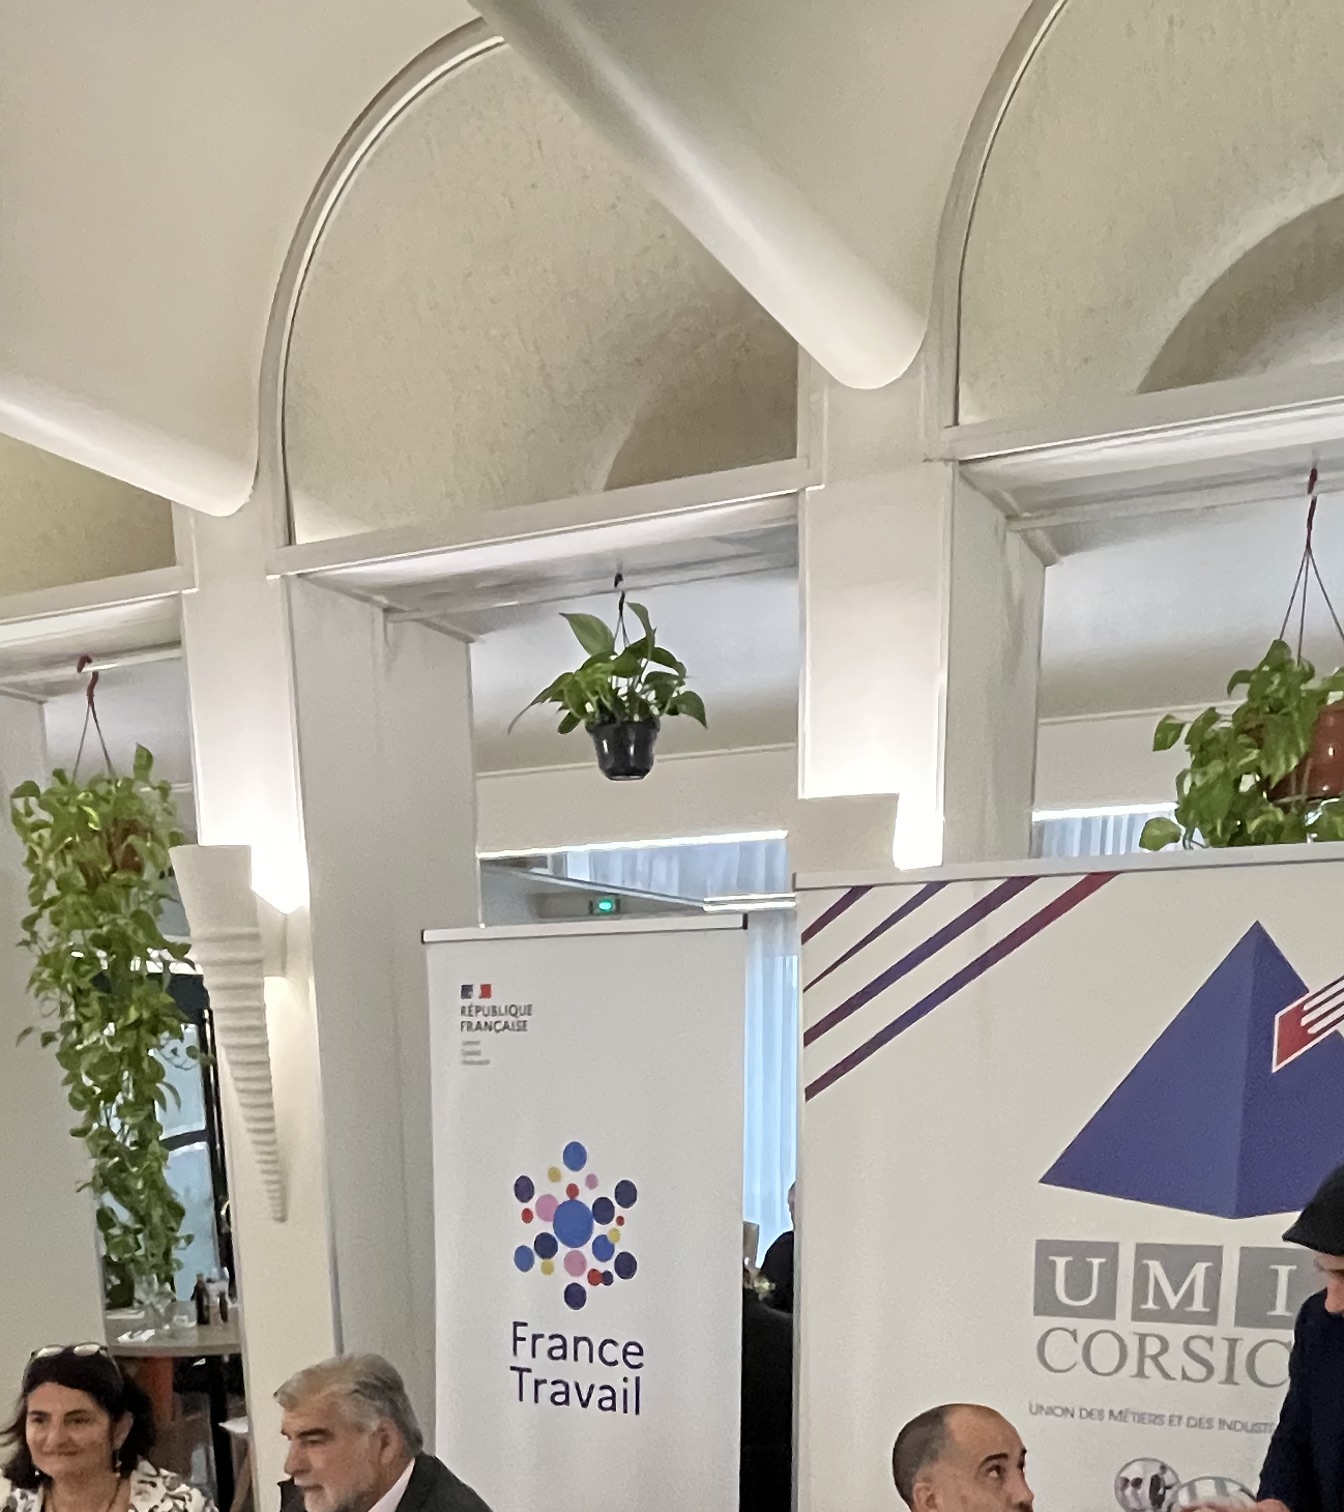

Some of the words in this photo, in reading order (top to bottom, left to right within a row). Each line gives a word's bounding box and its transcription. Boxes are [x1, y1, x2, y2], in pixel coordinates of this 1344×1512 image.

[460, 1003, 533, 1018] RÉPUBLIQUE
[460, 1020, 528, 1034] FRANÇAISE
[512, 1321, 644, 1369] France
[1036, 1327, 1293, 1388] CORSIC
[509, 1366, 641, 1415] Travail
[1029, 1402, 1075, 1419] UNION
[1079, 1406, 1105, 1421] DES
[1108, 1407, 1165, 1427] MÉTIERS
[1168, 1413, 1183, 1428] ET
[1186, 1415, 1214, 1430] DES
